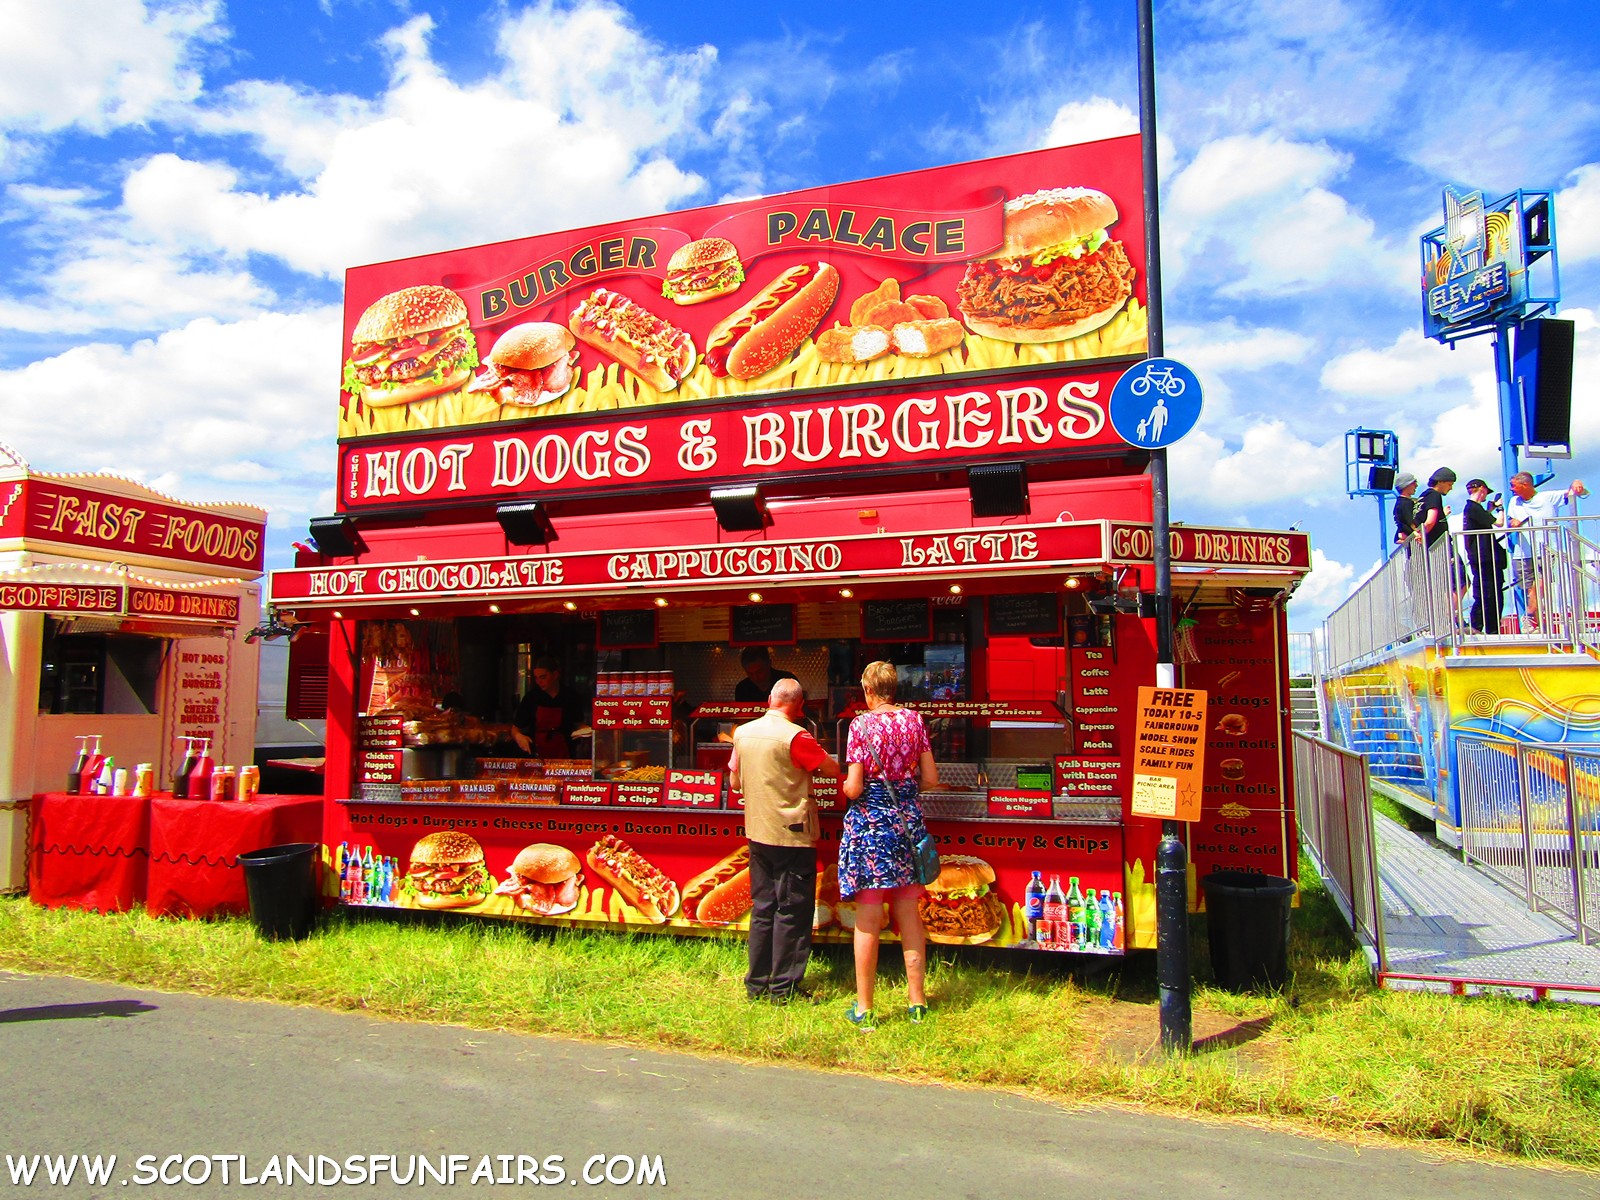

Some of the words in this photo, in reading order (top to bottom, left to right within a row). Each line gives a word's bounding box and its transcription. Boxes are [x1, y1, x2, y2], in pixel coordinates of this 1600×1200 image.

[767, 209, 965, 257] PALACE
[482, 237, 658, 320] BURGER
[1432, 264, 1504, 310] ELEVATE
[363, 443, 474, 498] HOT
[491, 425, 651, 487] DOGS
[678, 418, 718, 471] &
[742, 380, 1106, 468] BURGERS
[350, 454, 360, 499] CHIPS
[50, 494, 146, 544] FAST
[163, 515, 259, 562] FOODS
[900, 531, 1040, 567] LATTE
[1194, 532, 1292, 564] DRINKS
[607, 543, 842, 581] CAPPUCCINO
[309, 570, 368, 595] HOT
[378, 559, 565, 593] CHOCOLATE
[0, 586, 118, 609] COFFEE
[133, 591, 175, 613] COLD
[180, 594, 237, 618] DRINKS
[182, 653, 200, 663] HOT
[202, 654, 225, 664] DOGS
[1086, 651, 1103, 659] Tea
[1229, 657, 1273, 666] Burgers
[1081, 669, 1110, 677] Coffee
[182, 679, 222, 689] BURGERS
[1083, 687, 1109, 696] Latte
[622, 700, 643, 708] Gravy
[649, 700, 670, 708] Curry
[1151, 691, 1195, 707] FREE
[1208, 695, 1225, 706] ot
[1229, 695, 1271, 708] dogs
[184, 704, 218, 714] CHEESE
[1075, 706, 1118, 714] Cappuccino
[1143, 708, 1176, 719] TODAY
[1180, 710, 1203, 720] 10-5
[180, 714, 220, 724] BURGERS
[373, 718, 400, 727] Burger
[597, 718, 616, 726] Chips
[622, 718, 643, 726] Chips
[649, 718, 669, 726] Chips
[1079, 723, 1115, 731] Espresso
[1144, 721, 1199, 732] FAIRGROUND
[360, 728, 377, 736] with
[1139, 733, 1169, 743] MODEL
[1171, 735, 1198, 745] SHOW
[1208, 740, 1235, 749] con
[1239, 739, 1277, 749] Rolls
[1083, 741, 1113, 749] Mocha
[365, 752, 395, 760] Chicken
[1139, 745, 1167, 755] SCALE
[1169, 747, 1195, 757] RIDES
[364, 761, 396, 770] Nuggets
[483, 761, 517, 770] KRAKAUER
[1058, 761, 1081, 769] 1/2lb
[1082, 760, 1121, 770] Burgers
[1140, 758, 1173, 769] FAMILY
[1175, 761, 1193, 770] FUN
[364, 772, 371, 780] &
[372, 772, 393, 781] Chips
[545, 769, 592, 777] KASENKRAINER
[1062, 772, 1086, 780] with
[1087, 772, 1118, 780] Bacon
[670, 772, 716, 786] Pork
[812, 776, 837, 784] icken
[459, 784, 496, 793] KRAKAUER
[509, 783, 556, 792] KASENKRAINER
[566, 784, 607, 793] Frankfurter
[618, 784, 660, 793] Sausage
[1067, 783, 1077, 791] &
[1078, 783, 1113, 791] Cheese
[1203, 783, 1231, 794] ork
[1235, 784, 1277, 795] Rolls
[569, 795, 583, 803] Hot
[584, 795, 602, 804] Dogs
[618, 795, 627, 803] &
[629, 795, 658, 804] Chips
[668, 789, 715, 804] Baps
[990, 796, 1017, 804] Chicken
[1018, 796, 1049, 805] Nuggets
[1013, 804, 1033, 812] Chips
[350, 813, 374, 825] Hot
[377, 813, 408, 827] dogs
[423, 815, 478, 830] Burgers
[493, 817, 543, 831] Cheese
[547, 819, 608, 834] Burgers
[624, 822, 672, 835] Bacon
[677, 823, 718, 836] Rolls
[1213, 823, 1257, 836] Chips
[973, 833, 1027, 850] Curry
[1032, 835, 1047, 848] &
[1053, 835, 1110, 854] Chips
[1196, 843, 1225, 853] Hot
[1228, 843, 1240, 853] &
[1244, 844, 1278, 855] Cold
[1211, 863, 1264, 874] Drinks
